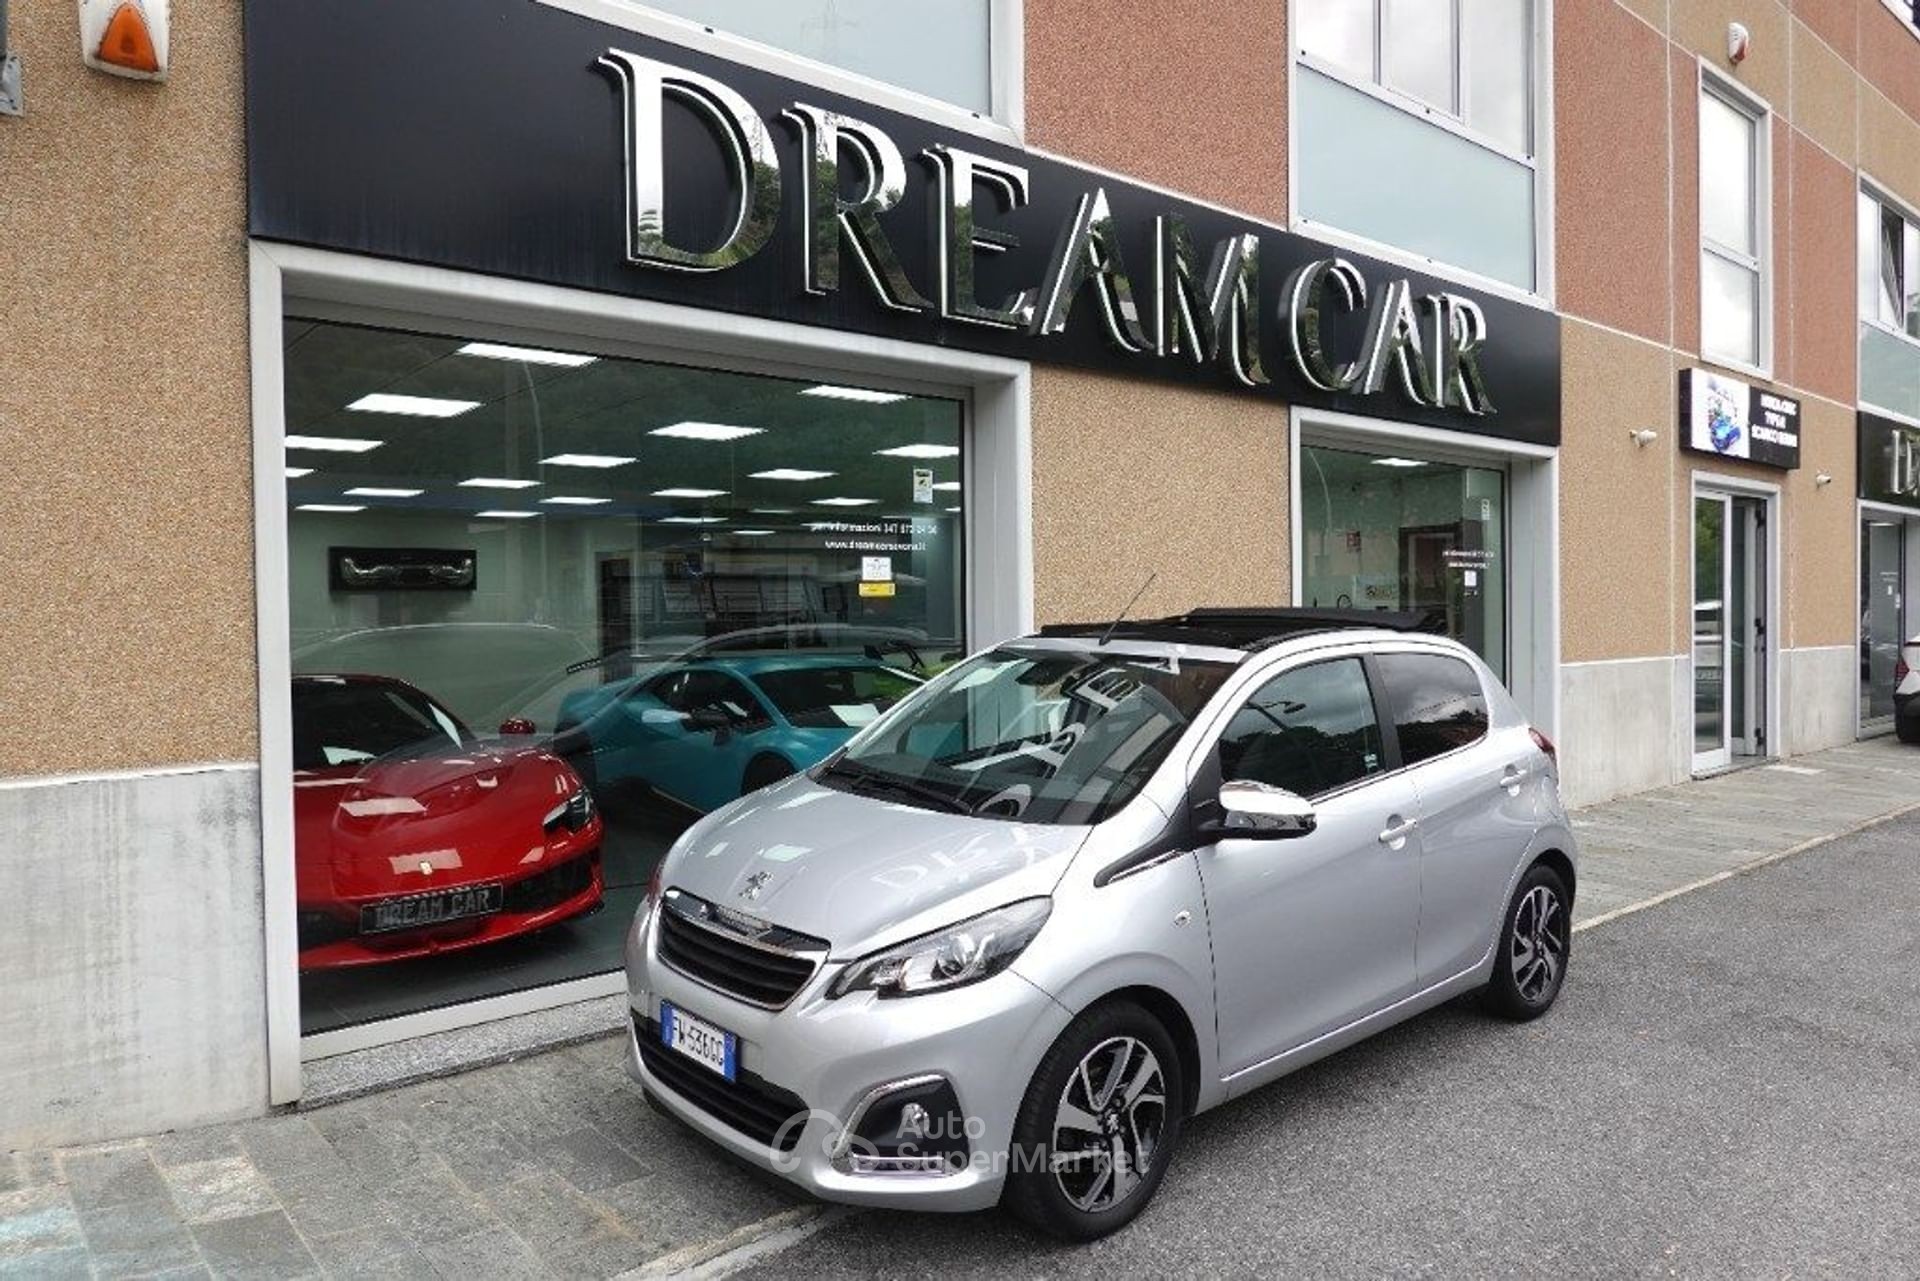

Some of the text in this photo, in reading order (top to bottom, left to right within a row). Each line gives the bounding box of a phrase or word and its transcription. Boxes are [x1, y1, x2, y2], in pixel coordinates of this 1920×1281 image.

[596, 46, 1499, 416] DREAM CAR
[375, 888, 490, 928] DREAM CAR
